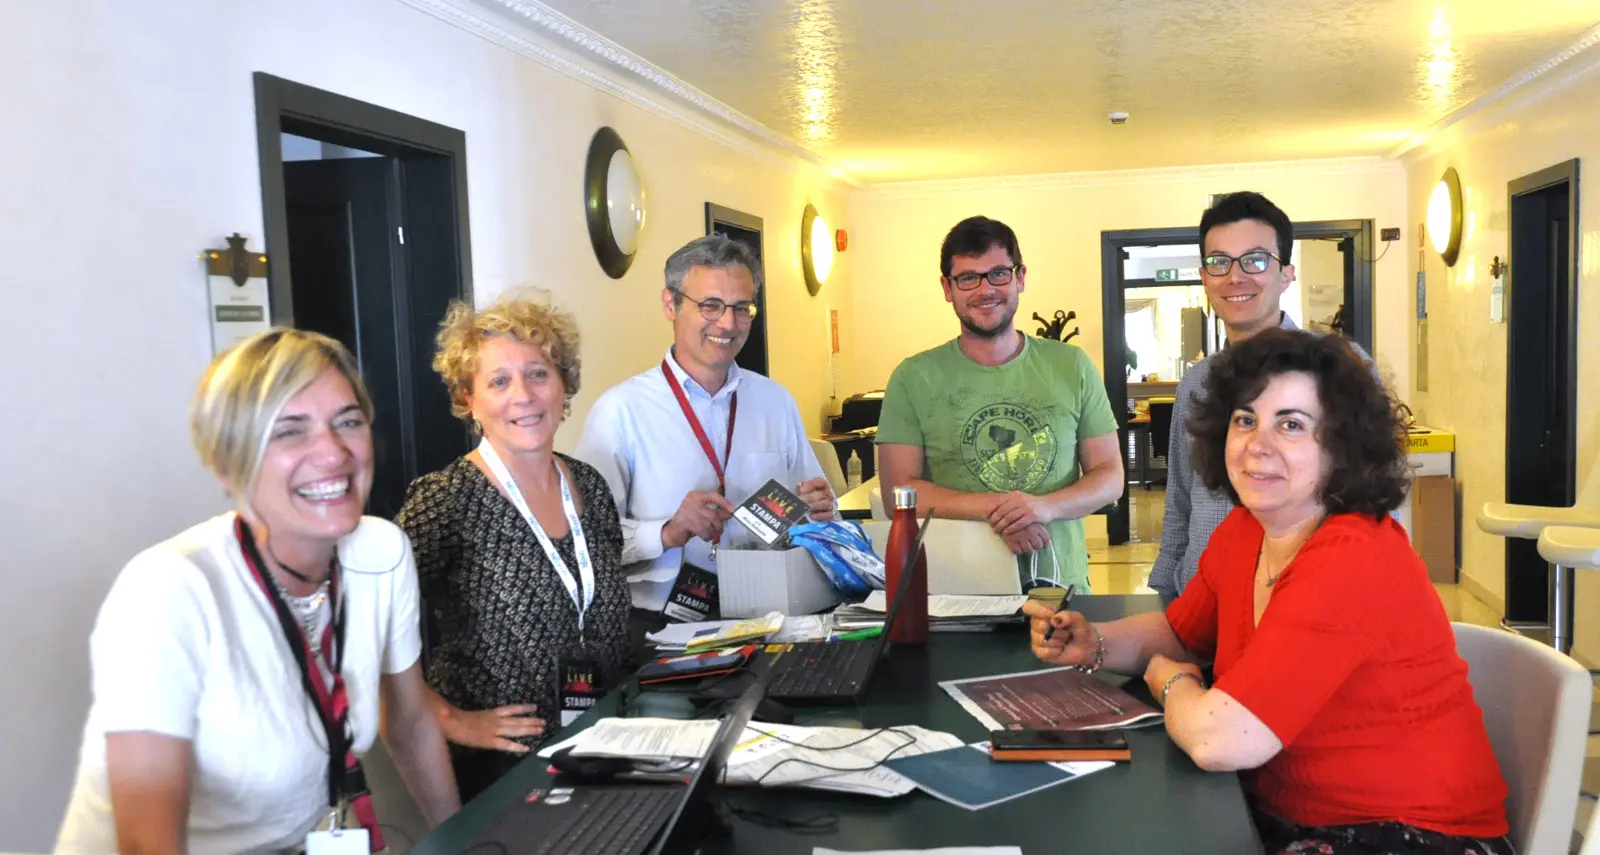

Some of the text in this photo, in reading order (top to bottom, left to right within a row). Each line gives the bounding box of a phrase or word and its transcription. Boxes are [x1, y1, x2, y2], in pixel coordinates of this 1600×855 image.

[1405, 437, 1428, 448] ARTA
[767, 491, 794, 514] LIVE
[749, 503, 781, 530] STAMPA
[676, 593, 710, 612] STAMPA
